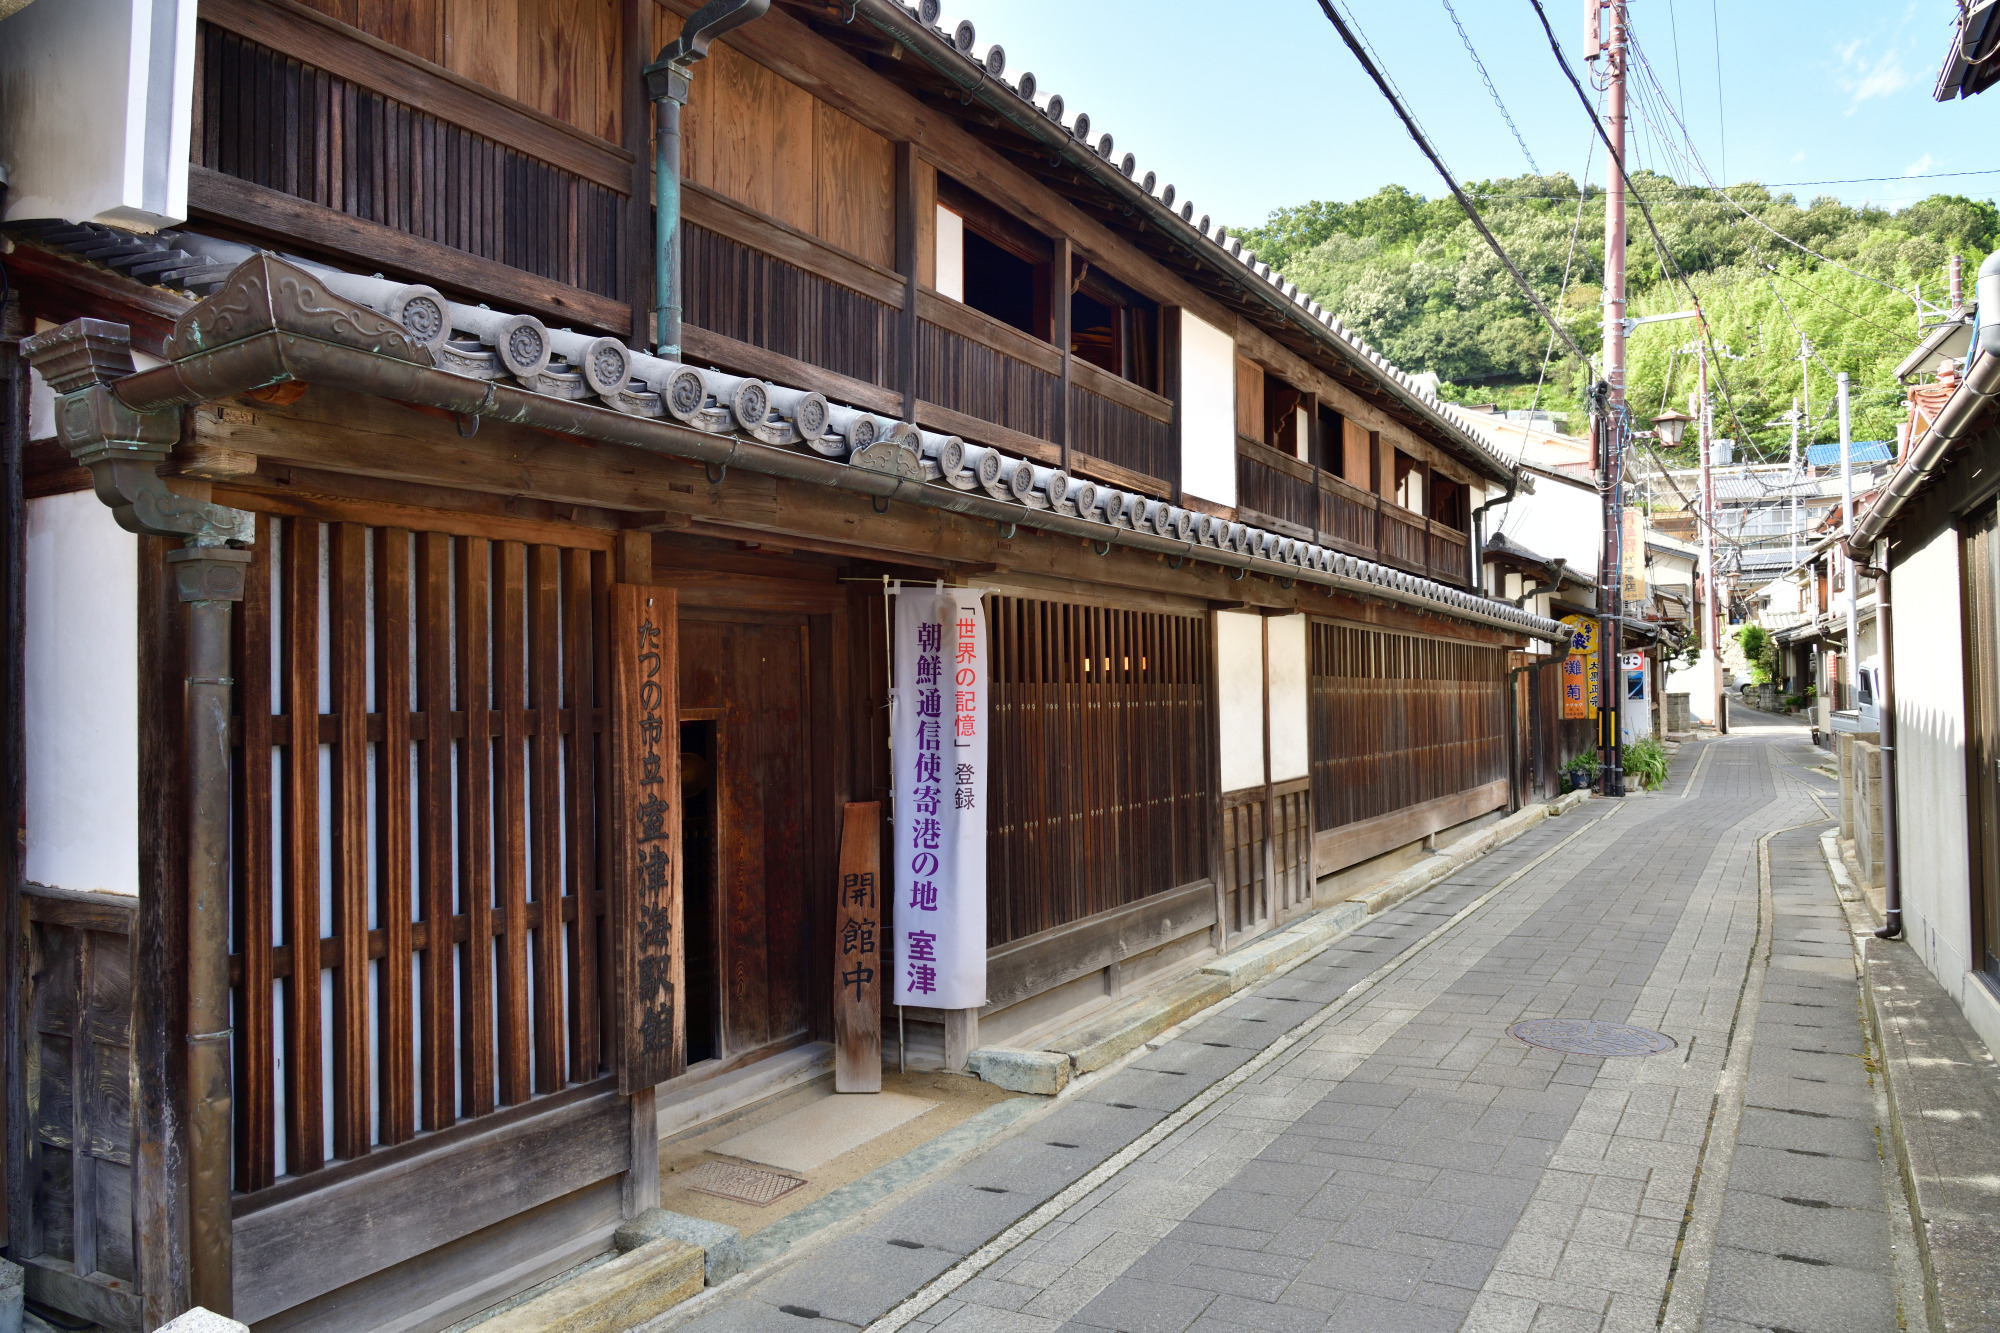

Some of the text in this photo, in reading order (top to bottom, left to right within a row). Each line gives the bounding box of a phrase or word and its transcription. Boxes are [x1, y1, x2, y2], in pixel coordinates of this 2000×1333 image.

[954, 606, 977, 810] 「世界の記憶」登録
[1563, 659, 1582, 701] 灘菊
[906, 622, 942, 995] 朝鮮通信使寄港の地 室津
[840, 872, 876, 1004] 開館中
